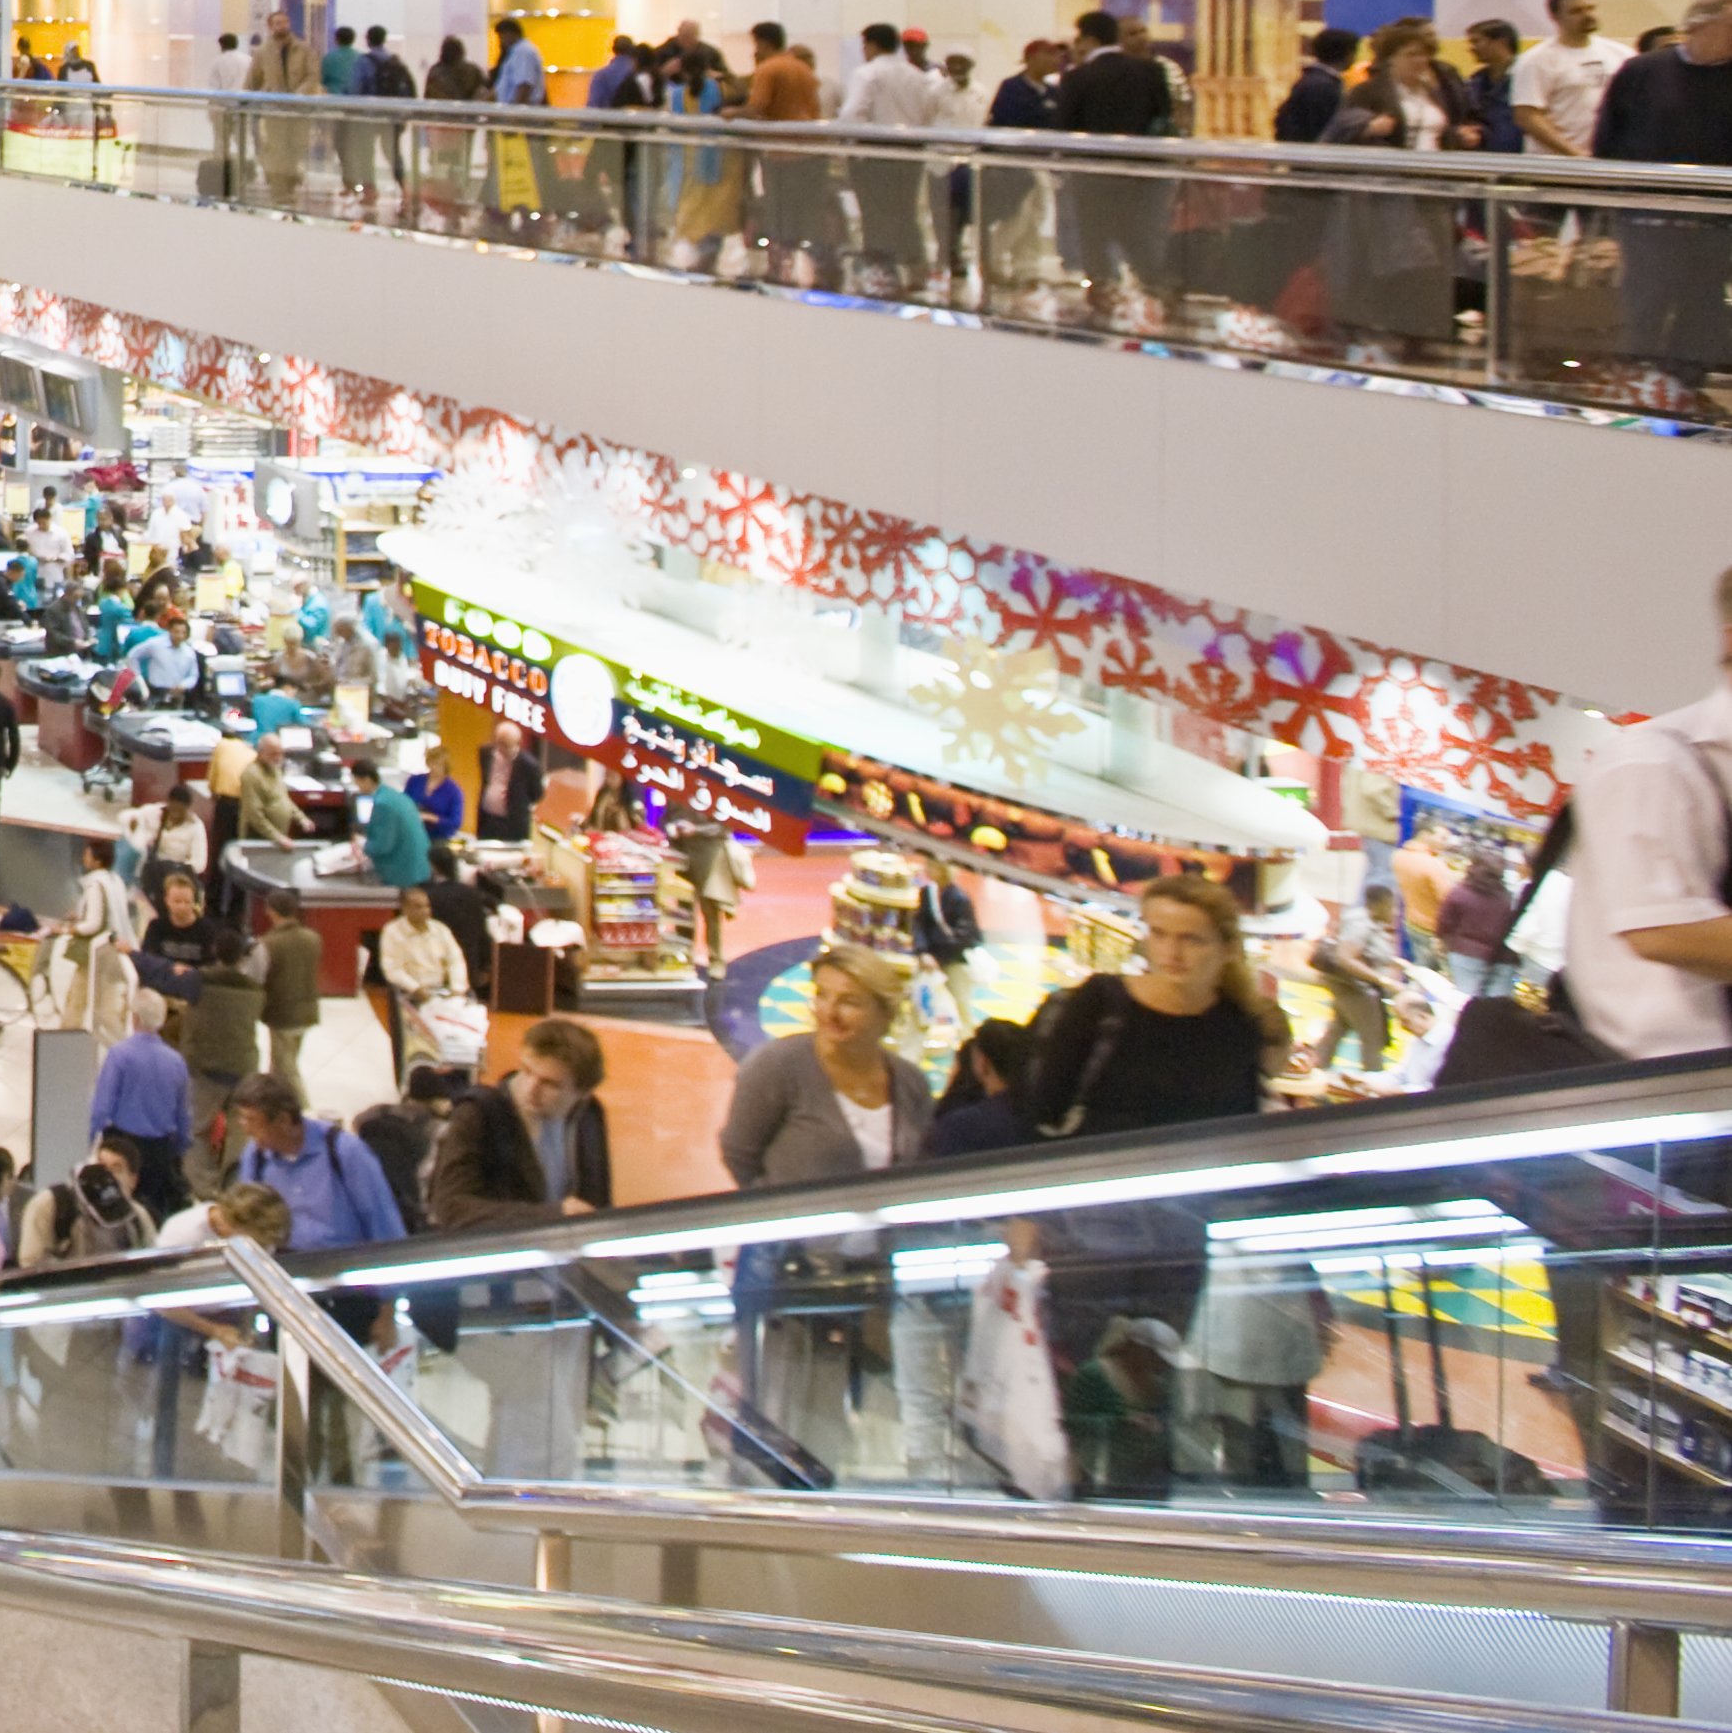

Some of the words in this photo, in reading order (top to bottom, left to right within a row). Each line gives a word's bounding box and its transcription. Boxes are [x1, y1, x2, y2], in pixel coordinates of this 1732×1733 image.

[422, 619, 548, 697] TOBACCO
[443, 597, 553, 662] FOOD
[433, 659, 488, 705] DUTY
[491, 684, 547, 734] FREE
[620, 748, 685, 792] الحرة
[688, 779, 772, 833] السوق
